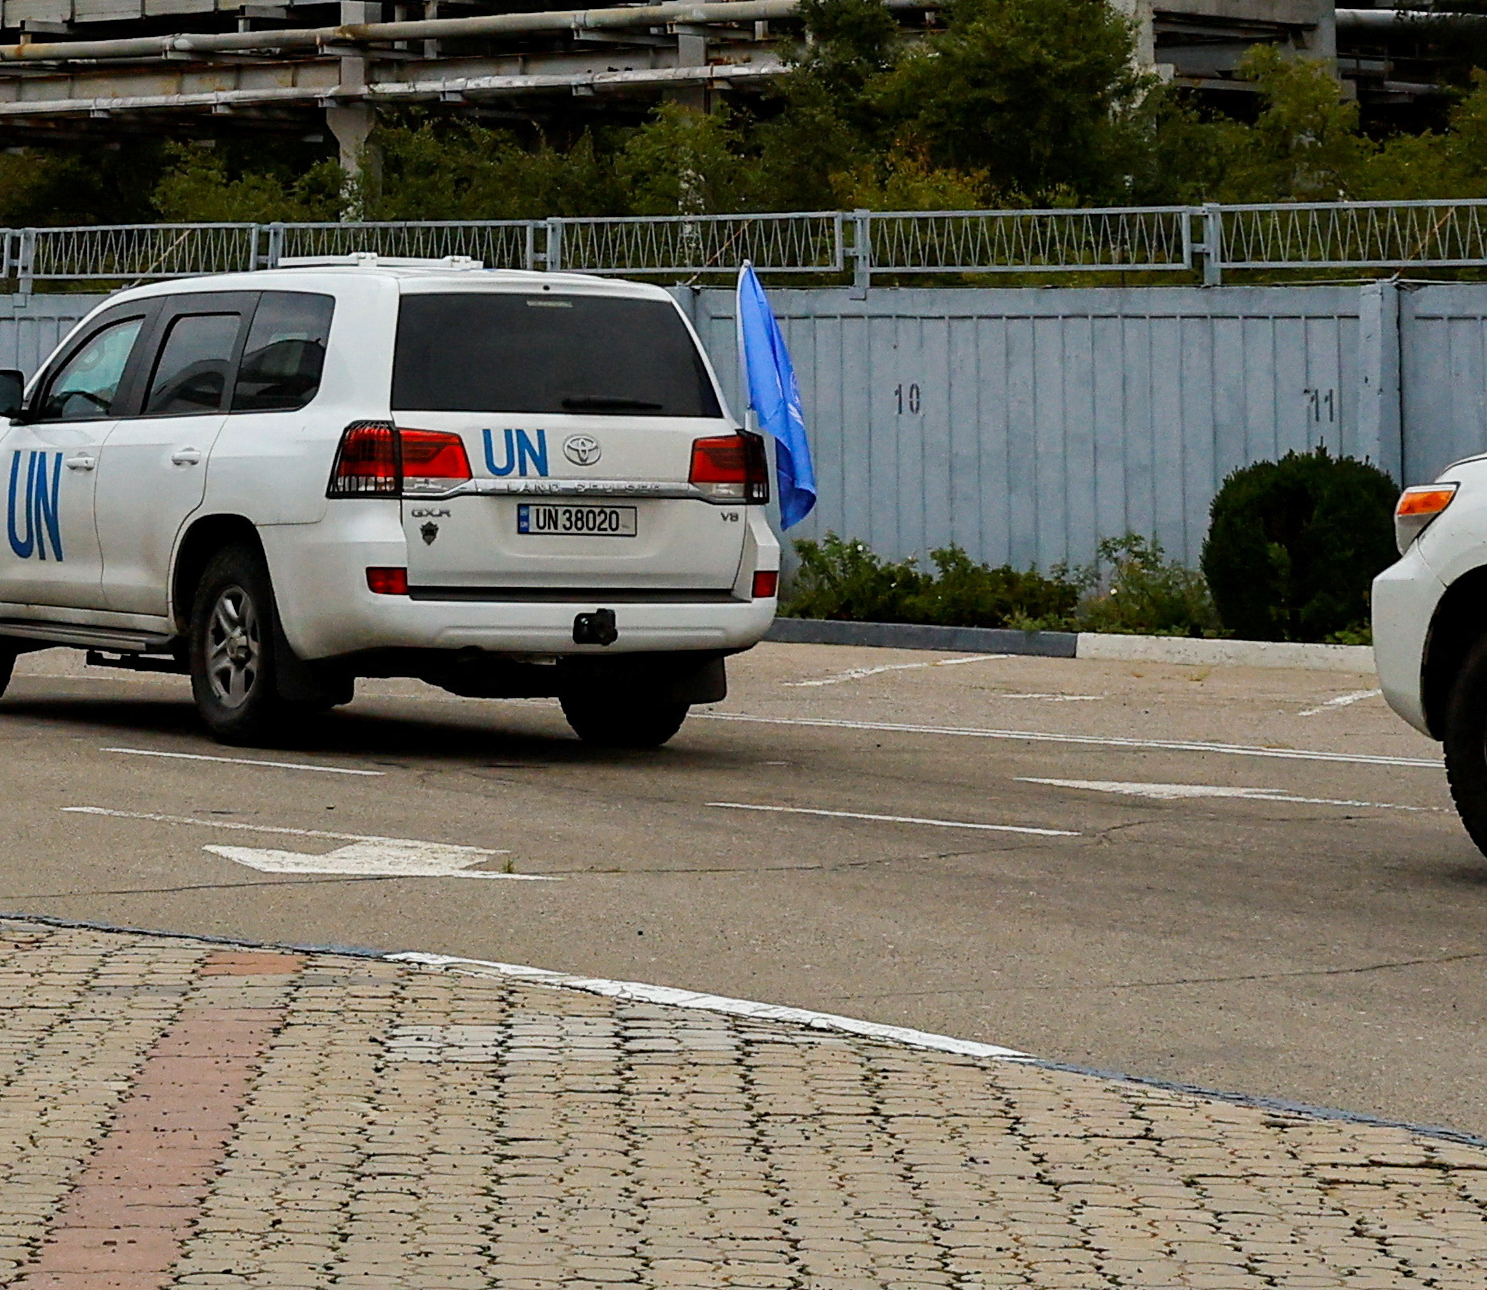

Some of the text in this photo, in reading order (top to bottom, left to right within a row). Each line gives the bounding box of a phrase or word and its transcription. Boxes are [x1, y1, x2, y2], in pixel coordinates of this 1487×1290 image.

[894, 383, 920, 414] 10
[482, 428, 549, 477] UN
[8, 450, 63, 562] UN
[411, 508, 452, 518] GXR
[720, 512, 739, 522] V8
[535, 508, 559, 531] UN
[562, 509, 620, 532] 38020
